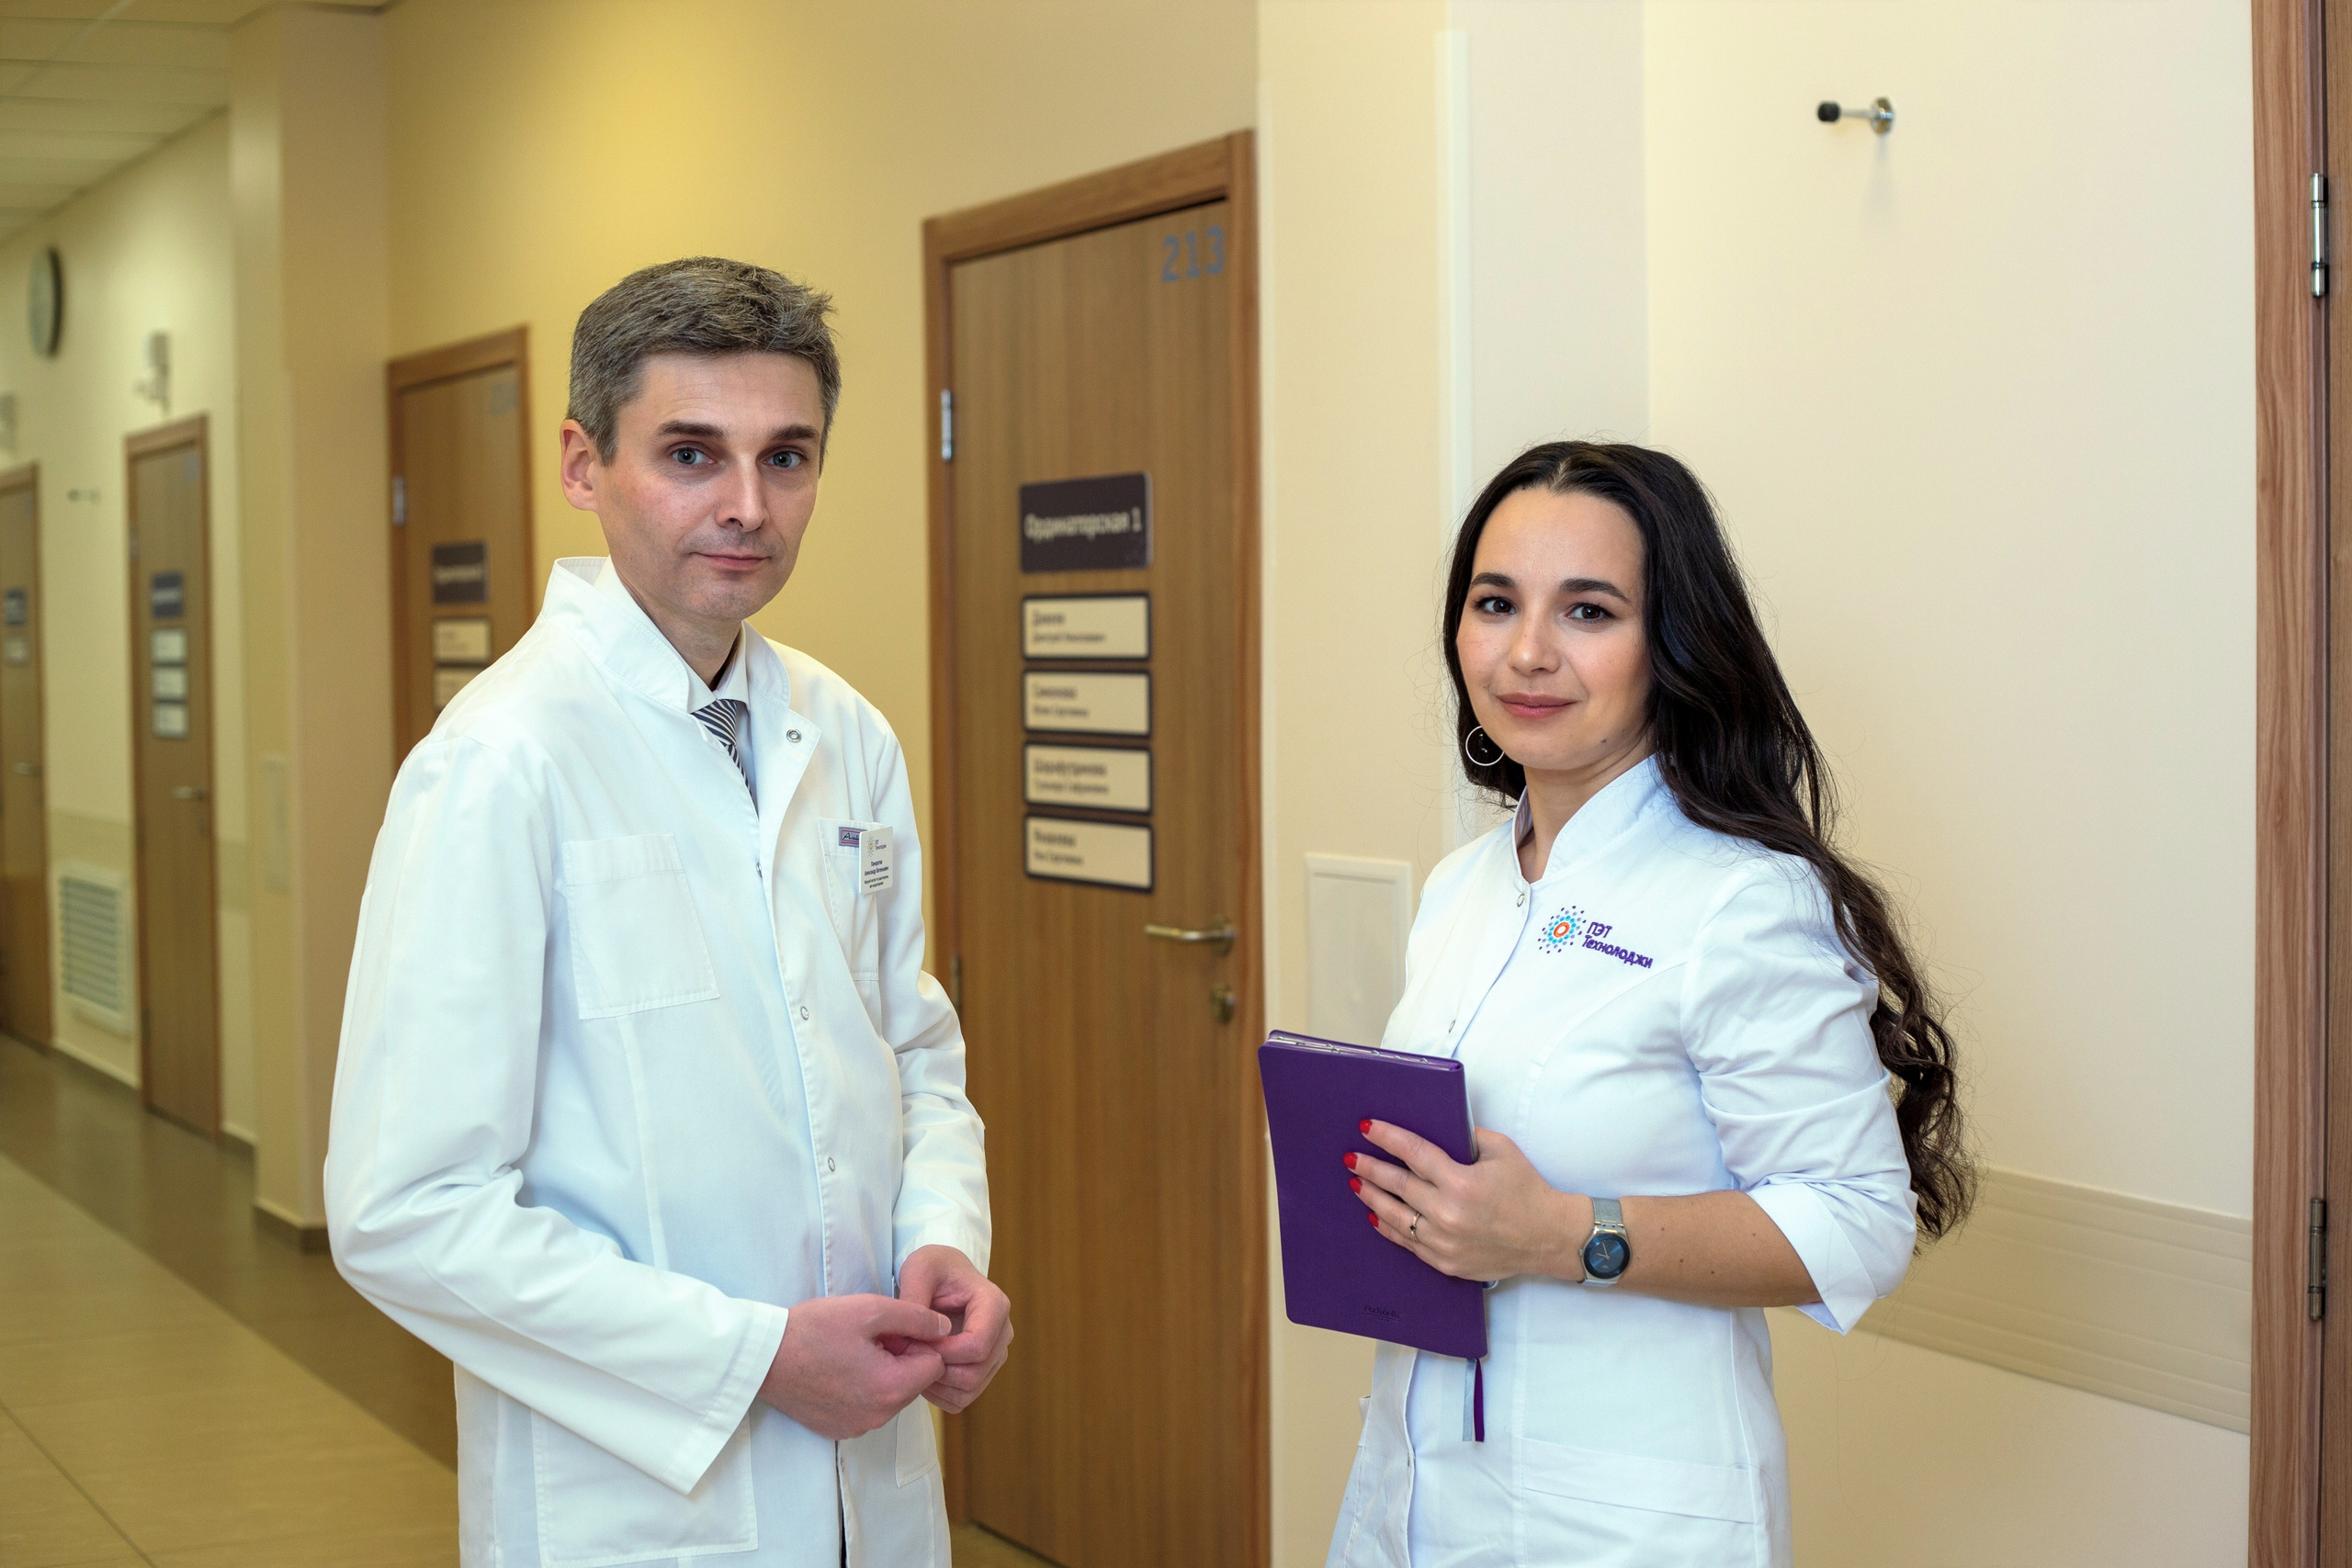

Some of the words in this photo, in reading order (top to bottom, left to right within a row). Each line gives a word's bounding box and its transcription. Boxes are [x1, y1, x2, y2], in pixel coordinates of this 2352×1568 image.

[1161, 225, 1226, 282] 213
[1131, 507, 1141, 533] 1
[1587, 921, 1612, 938] ПЭТ
[1582, 934, 1653, 968] Технолоджи
